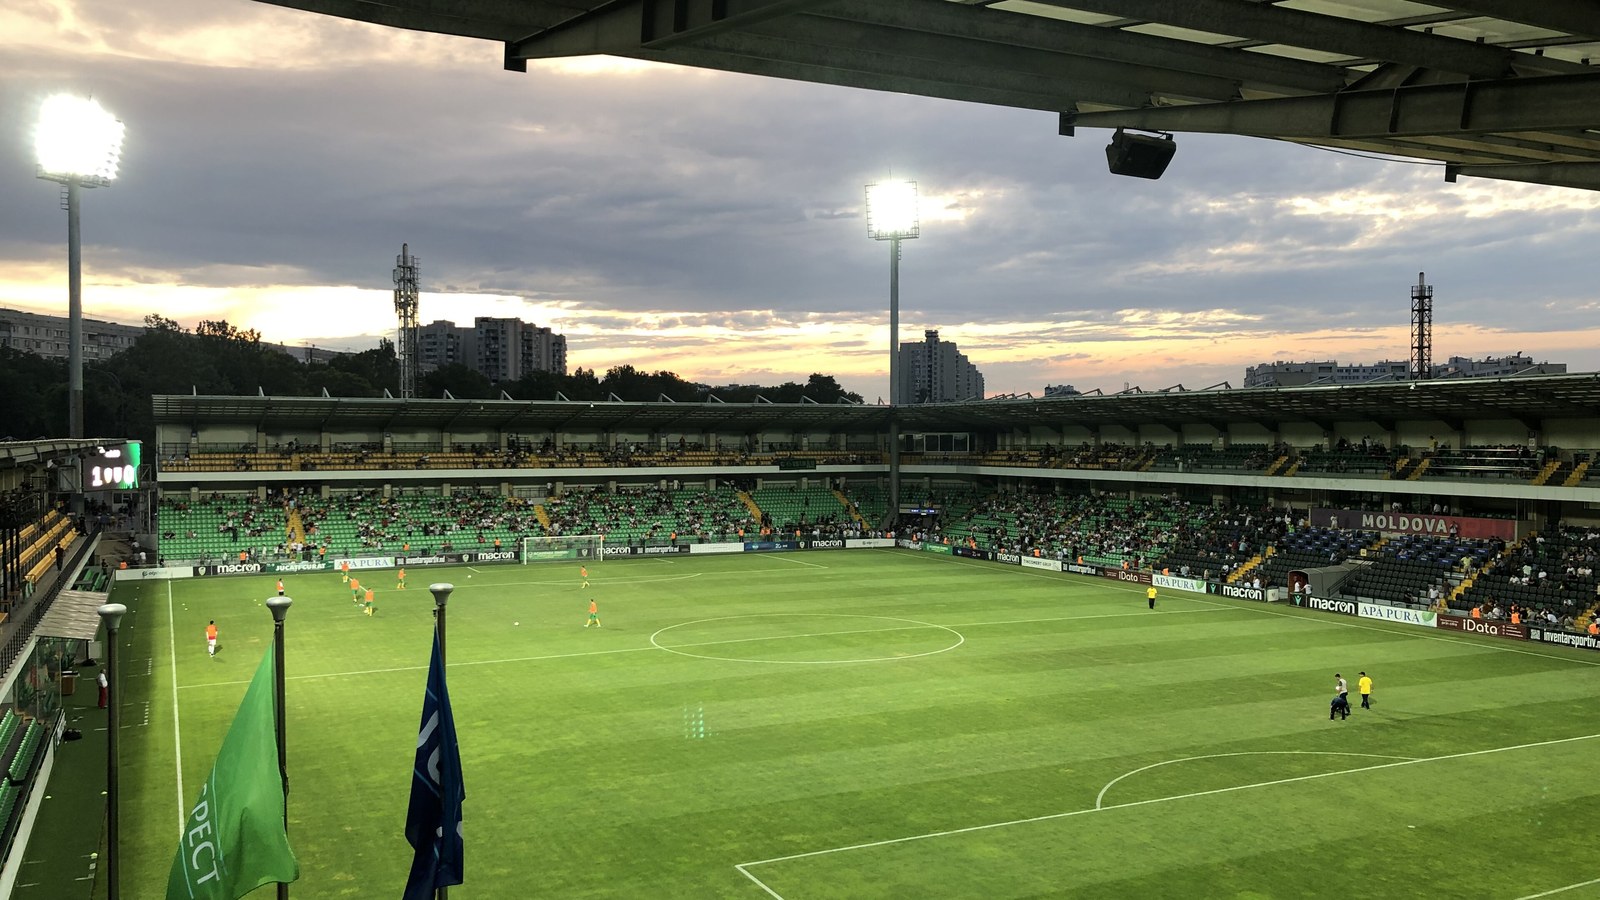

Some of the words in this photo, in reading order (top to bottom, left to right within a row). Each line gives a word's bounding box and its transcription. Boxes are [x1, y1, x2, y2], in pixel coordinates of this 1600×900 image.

[1362, 514, 1448, 533] MOLDOVA
[812, 539, 842, 548] macron
[478, 551, 515, 560] macron
[997, 552, 1020, 563] macron
[217, 563, 261, 573] macron
[1119, 571, 1138, 582] iData
[1223, 585, 1262, 600] macron
[1310, 598, 1355, 614] macron
[1462, 619, 1498, 635] iData
[188, 783, 220, 885] PECT
